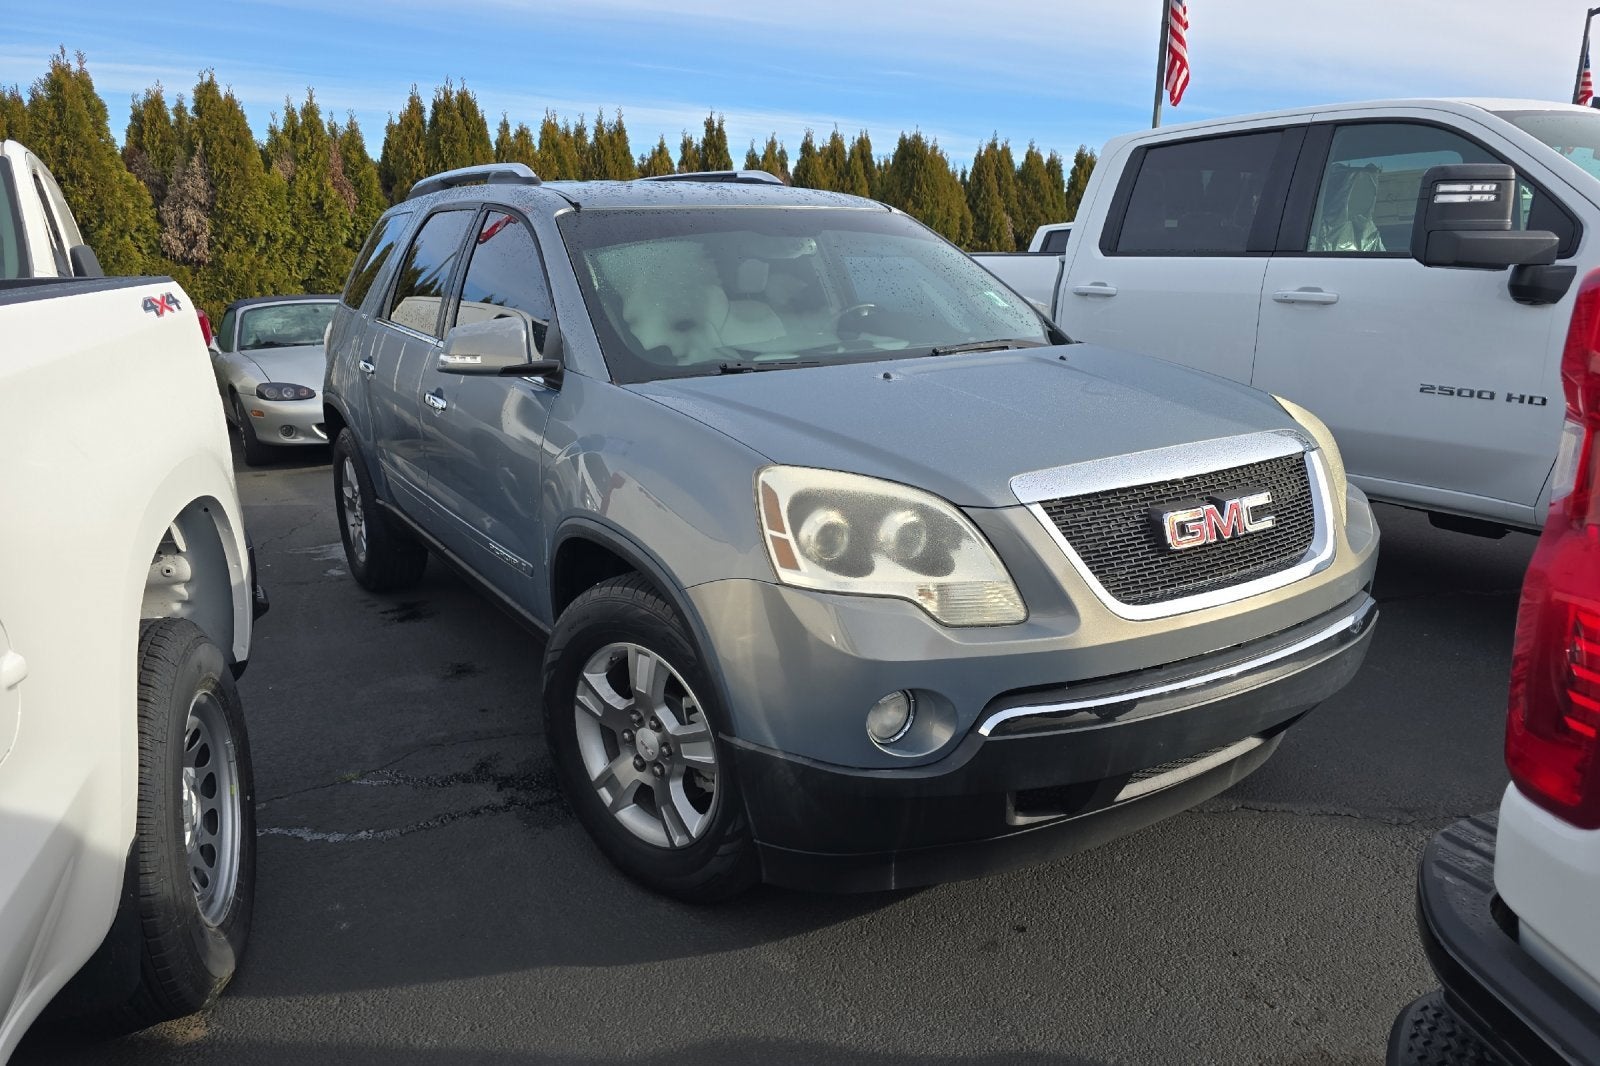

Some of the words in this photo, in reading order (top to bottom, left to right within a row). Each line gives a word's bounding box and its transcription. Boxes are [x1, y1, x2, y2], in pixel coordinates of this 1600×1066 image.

[1419, 383, 1495, 401] 2500
[1506, 392, 1547, 406] HD
[1162, 491, 1276, 550] GMC
